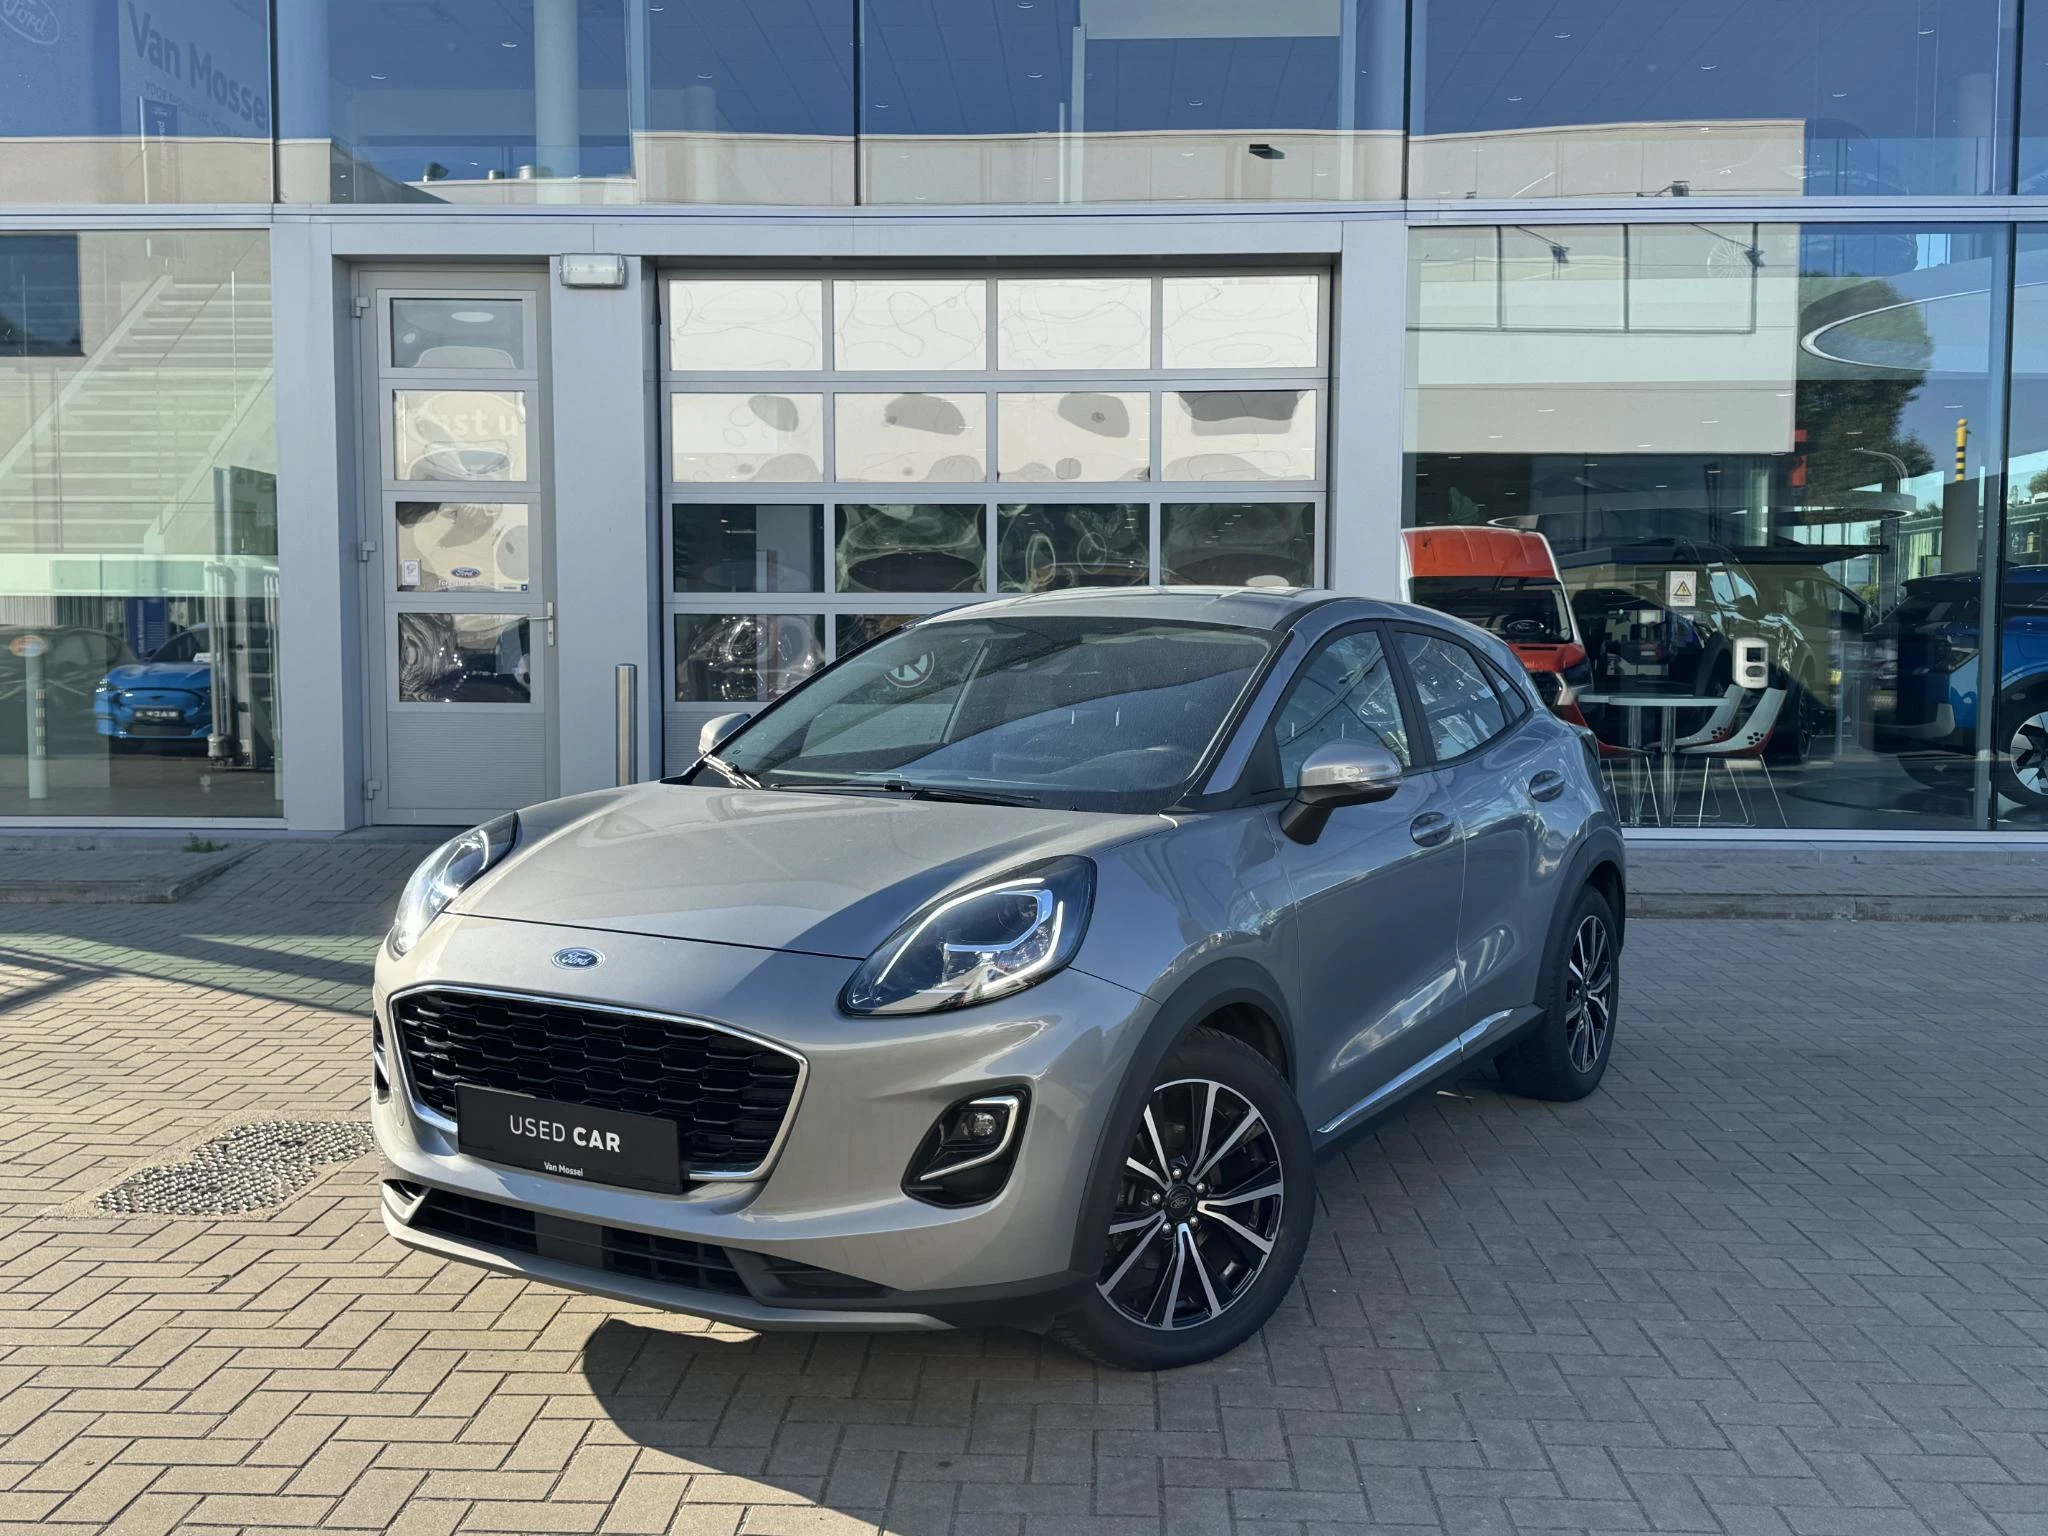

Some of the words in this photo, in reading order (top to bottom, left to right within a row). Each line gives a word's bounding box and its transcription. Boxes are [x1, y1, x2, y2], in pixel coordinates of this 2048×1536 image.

[127, 0, 181, 80] Van
[189, 41, 267, 130] Mosse
[509, 1114, 566, 1142] USED
[572, 1126, 621, 1152] CAR
[543, 1161, 558, 1173] Van
[558, 1164, 584, 1177] Mossel
